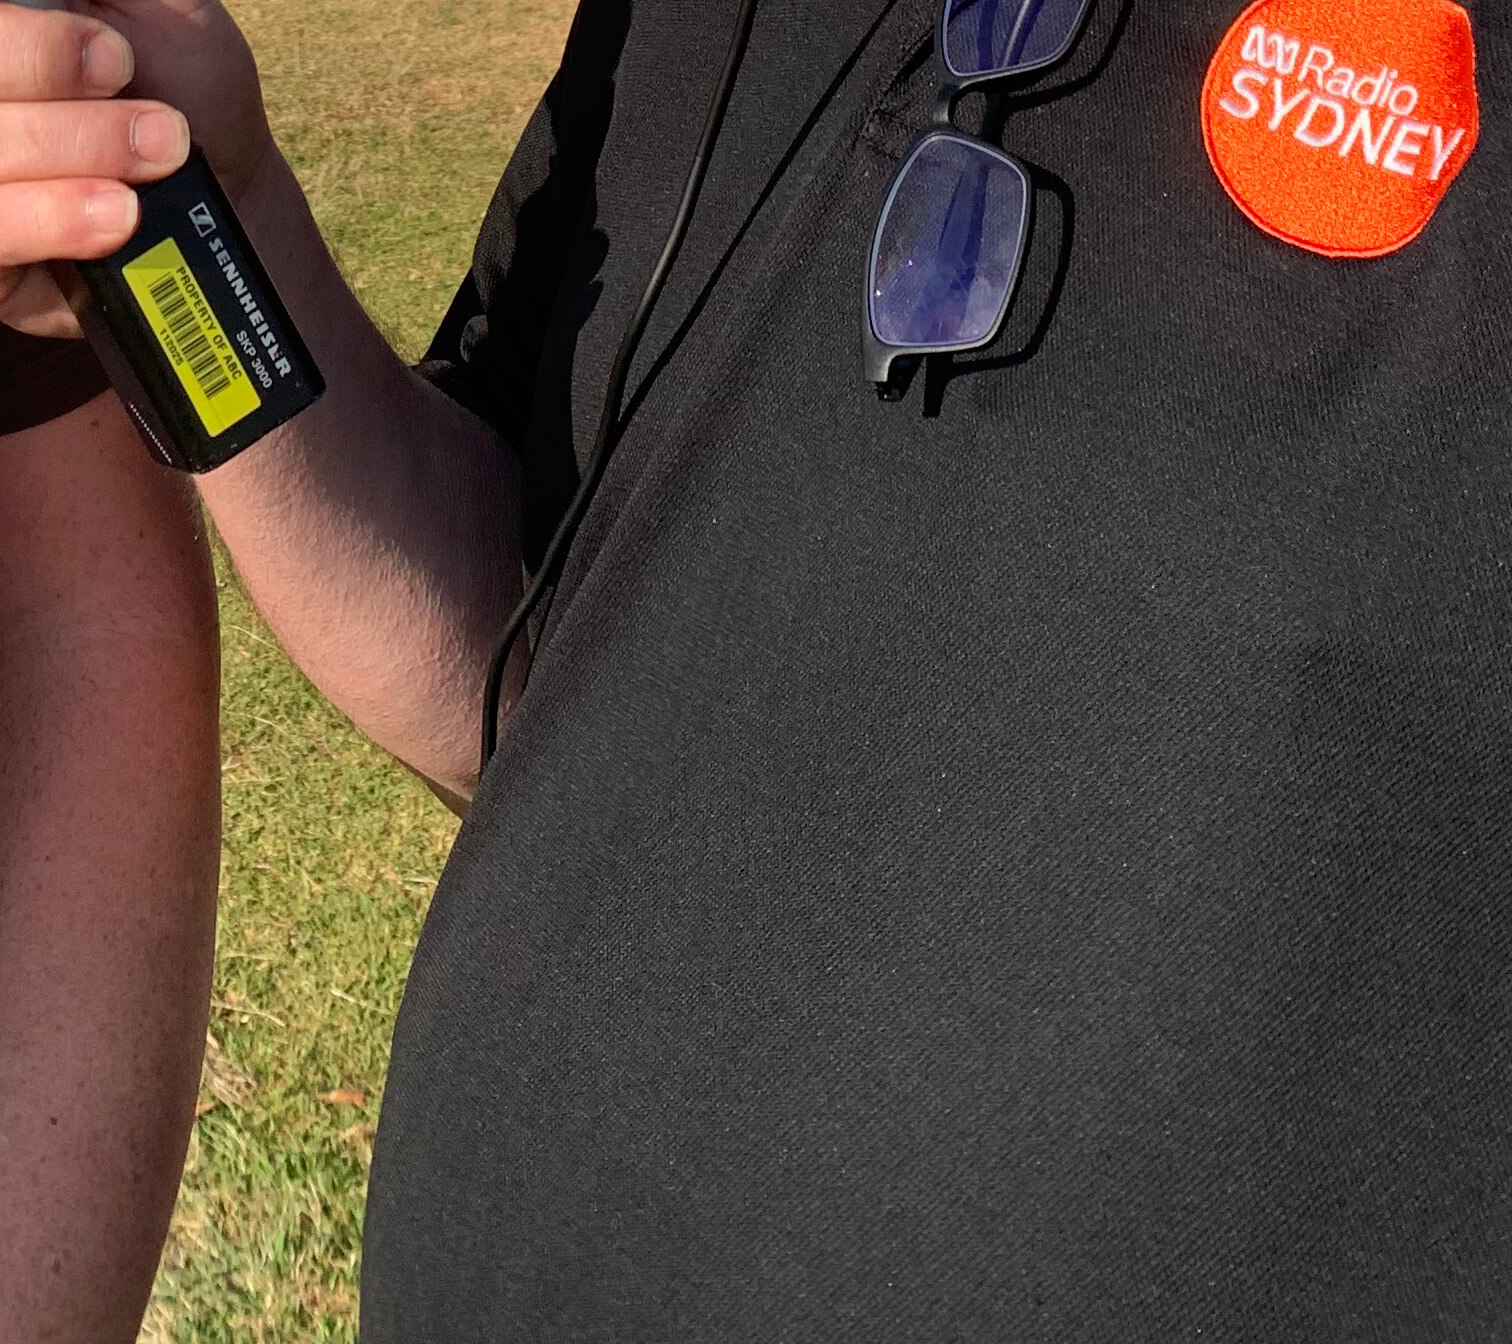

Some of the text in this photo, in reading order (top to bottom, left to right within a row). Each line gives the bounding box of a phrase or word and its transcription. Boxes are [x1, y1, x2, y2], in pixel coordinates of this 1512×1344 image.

[1219, 67, 1466, 181] SYDNEY
[1298, 43, 1418, 116] Radio
[176, 266, 243, 381] PROPERTY OF ABC
[208, 237, 292, 378] SENNHEISER
[236, 330, 273, 389] SKP 3000
